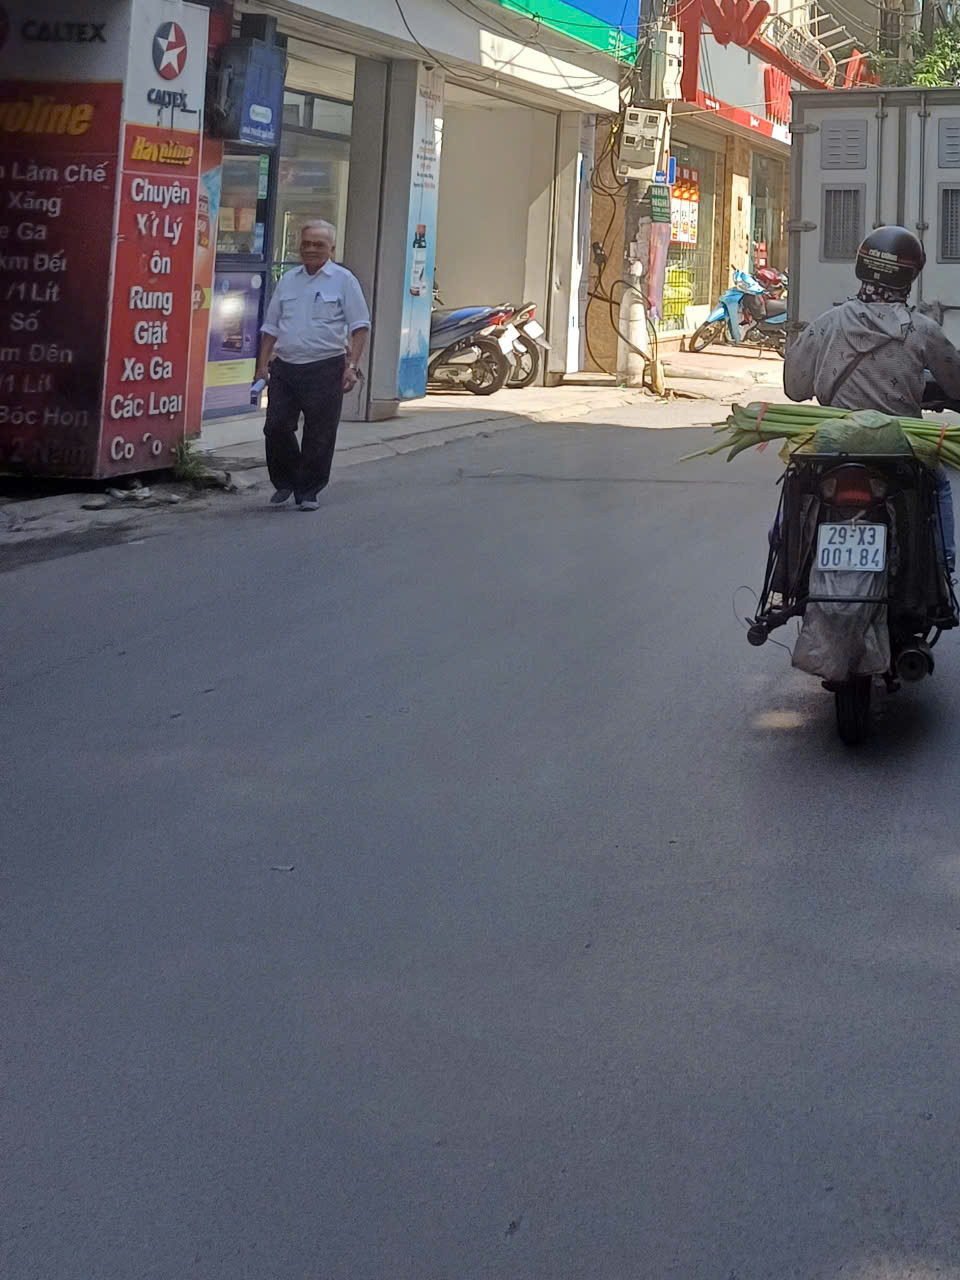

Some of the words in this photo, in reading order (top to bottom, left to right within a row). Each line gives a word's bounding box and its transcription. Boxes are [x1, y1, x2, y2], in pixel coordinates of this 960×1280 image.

[147, 87, 188, 109] CALTEX
[64, 160, 109, 183] Chế
[8, 191, 62, 217] Xăng
[131, 177, 190, 209] Chuyên
[17, 222, 48, 240] Ga
[163, 214, 183, 246] Lý
[129, 285, 173, 315] Rung
[10, 309, 39, 331] Số
[134, 321, 168, 350] Giật
[121, 357, 144, 381] Xe
[149, 356, 172, 380] Ga
[110, 392, 144, 419] Các
[828, 526, 876, 546] 29-X3
[821, 547, 880, 567] 001.84
